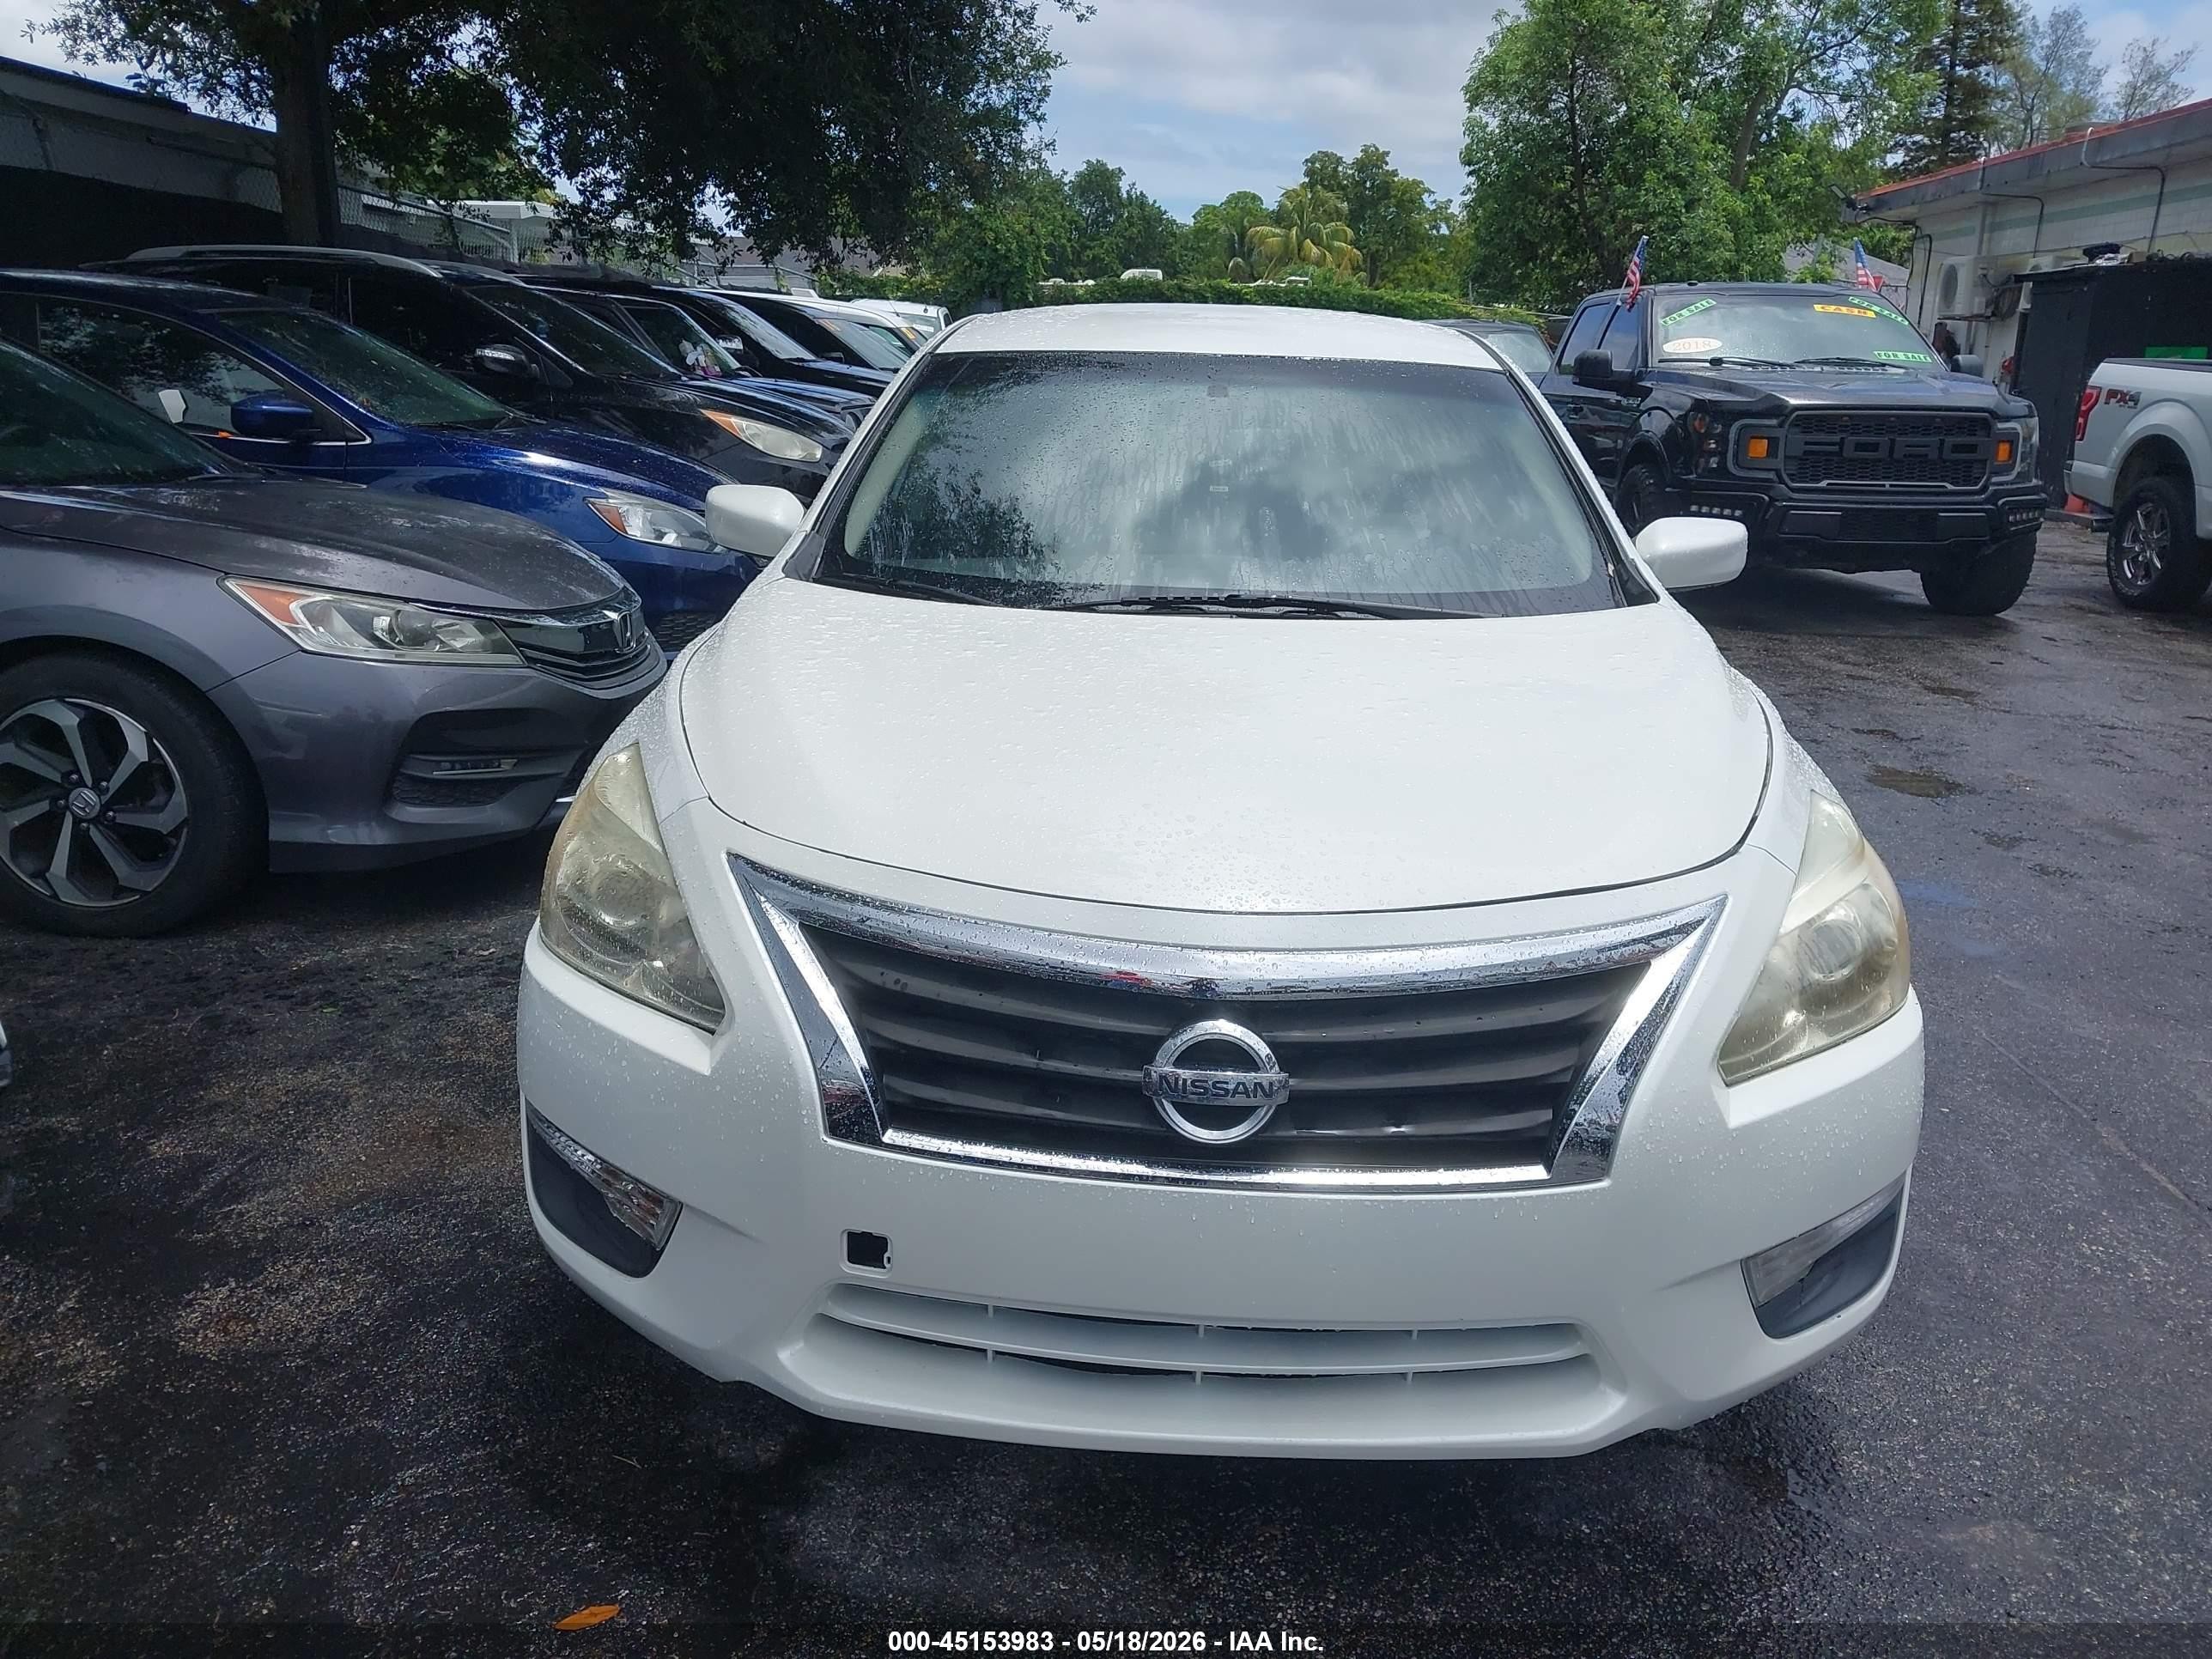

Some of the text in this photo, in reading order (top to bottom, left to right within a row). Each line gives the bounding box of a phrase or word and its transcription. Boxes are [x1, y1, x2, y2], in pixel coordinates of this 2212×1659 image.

[1662, 299, 1713, 325] FOR SALE
[1820, 305, 1869, 315] CASH
[1673, 340, 1711, 351] 2018
[1903, 353, 1929, 362] SALE
[2104, 388, 2142, 406] FX4
[1786, 435, 1990, 460] FORD
[1159, 1076, 1274, 1100] NISSAN
